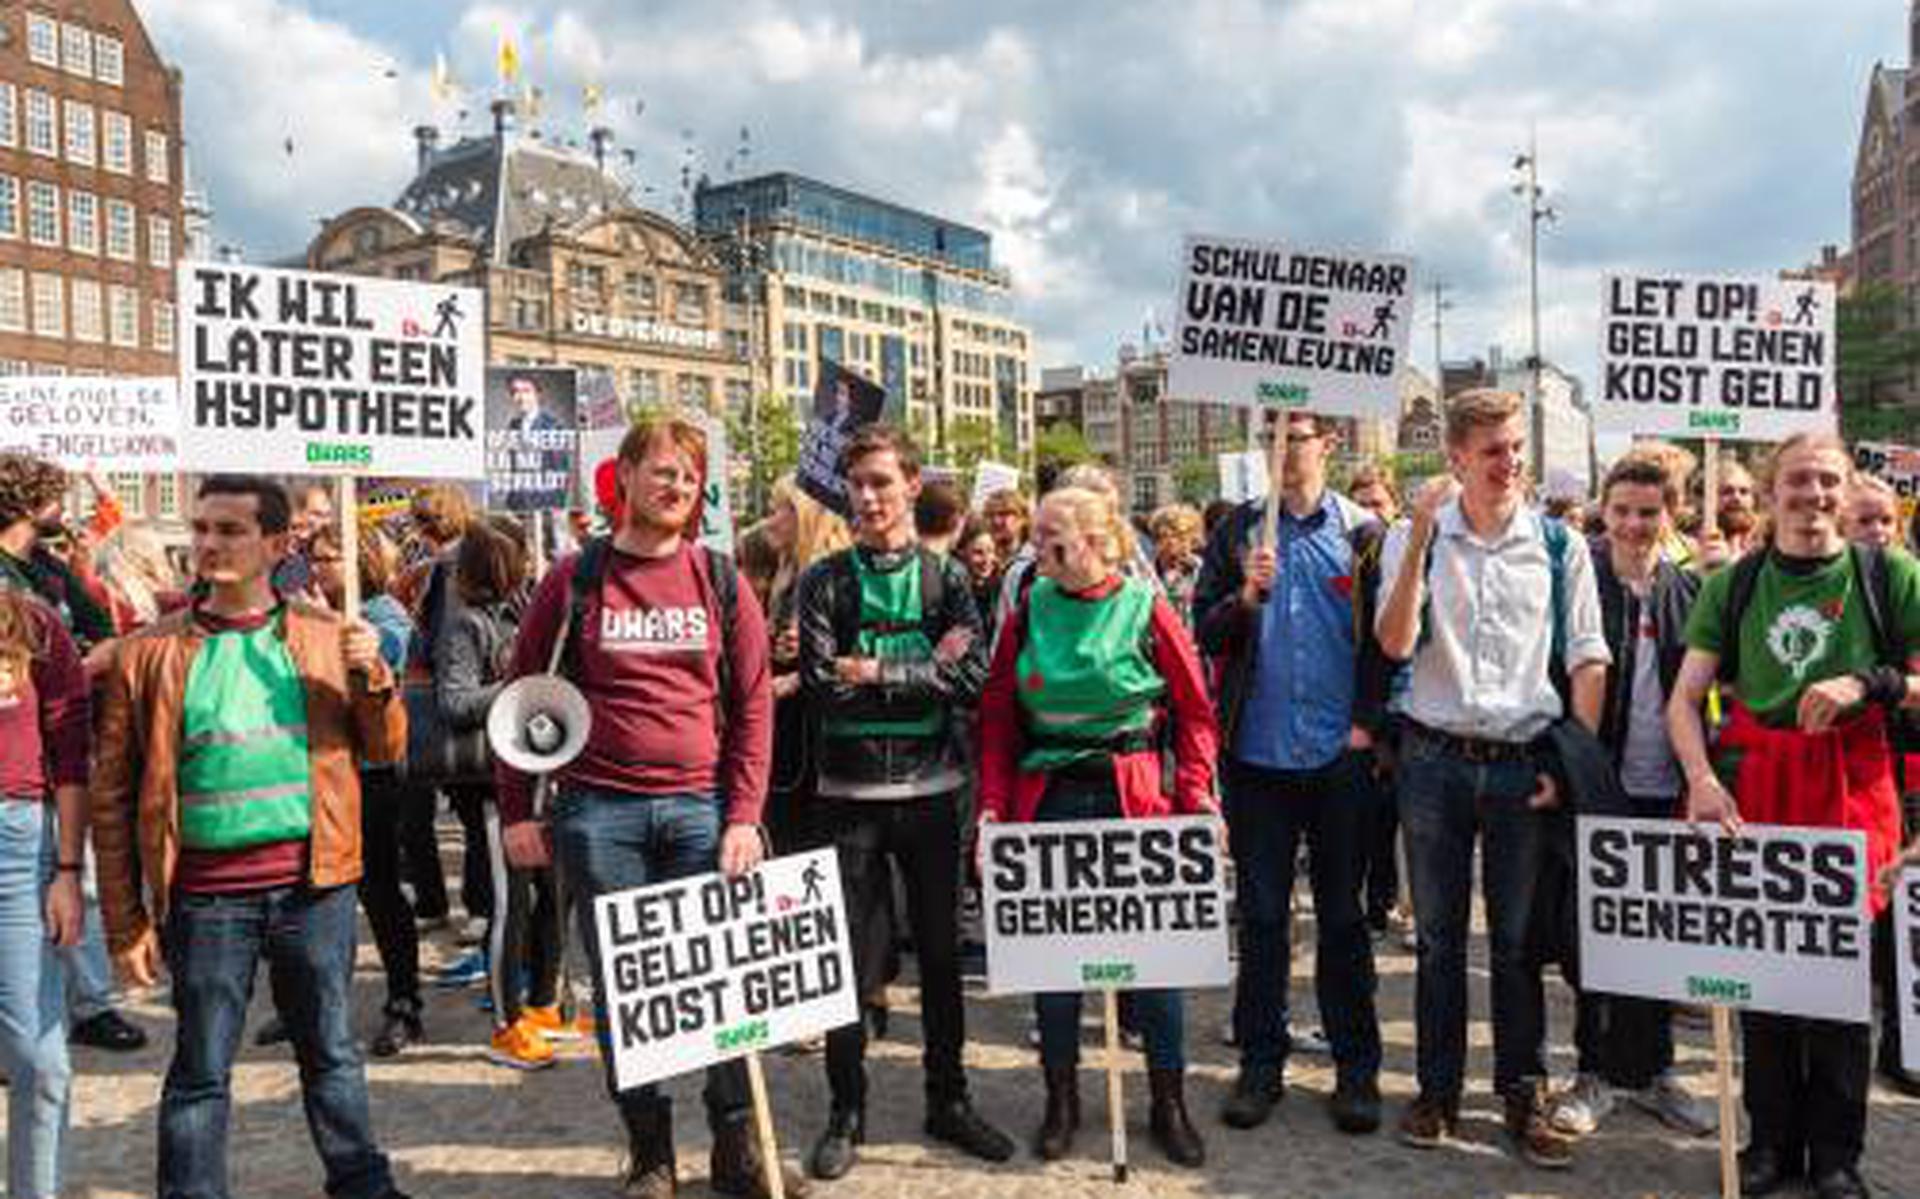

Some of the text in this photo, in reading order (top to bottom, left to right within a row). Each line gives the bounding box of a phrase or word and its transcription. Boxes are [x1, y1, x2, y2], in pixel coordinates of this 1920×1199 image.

[195, 270, 373, 330] IK WIL
[1192, 245, 1406, 296] SCHULDENAAR
[1611, 278, 1758, 322] LET OP!
[1187, 281, 1329, 334] VAN DE
[195, 325, 457, 388] LATER EEN
[1182, 326, 1395, 376] SAMENLEVING
[1608, 322, 1823, 367] GELD LENEN
[195, 380, 474, 439] HYPOTHEEK
[1605, 362, 1822, 411] KOST GELD
[990, 827, 1215, 892] STRESS
[1589, 828, 1857, 907] STRESS
[607, 872, 767, 946] LET OP!
[994, 891, 1218, 936] GENERATIE
[1591, 896, 1860, 958] GENERATIE
[613, 904, 838, 994] GELD LENEN
[618, 950, 843, 1048] KOST GELD
